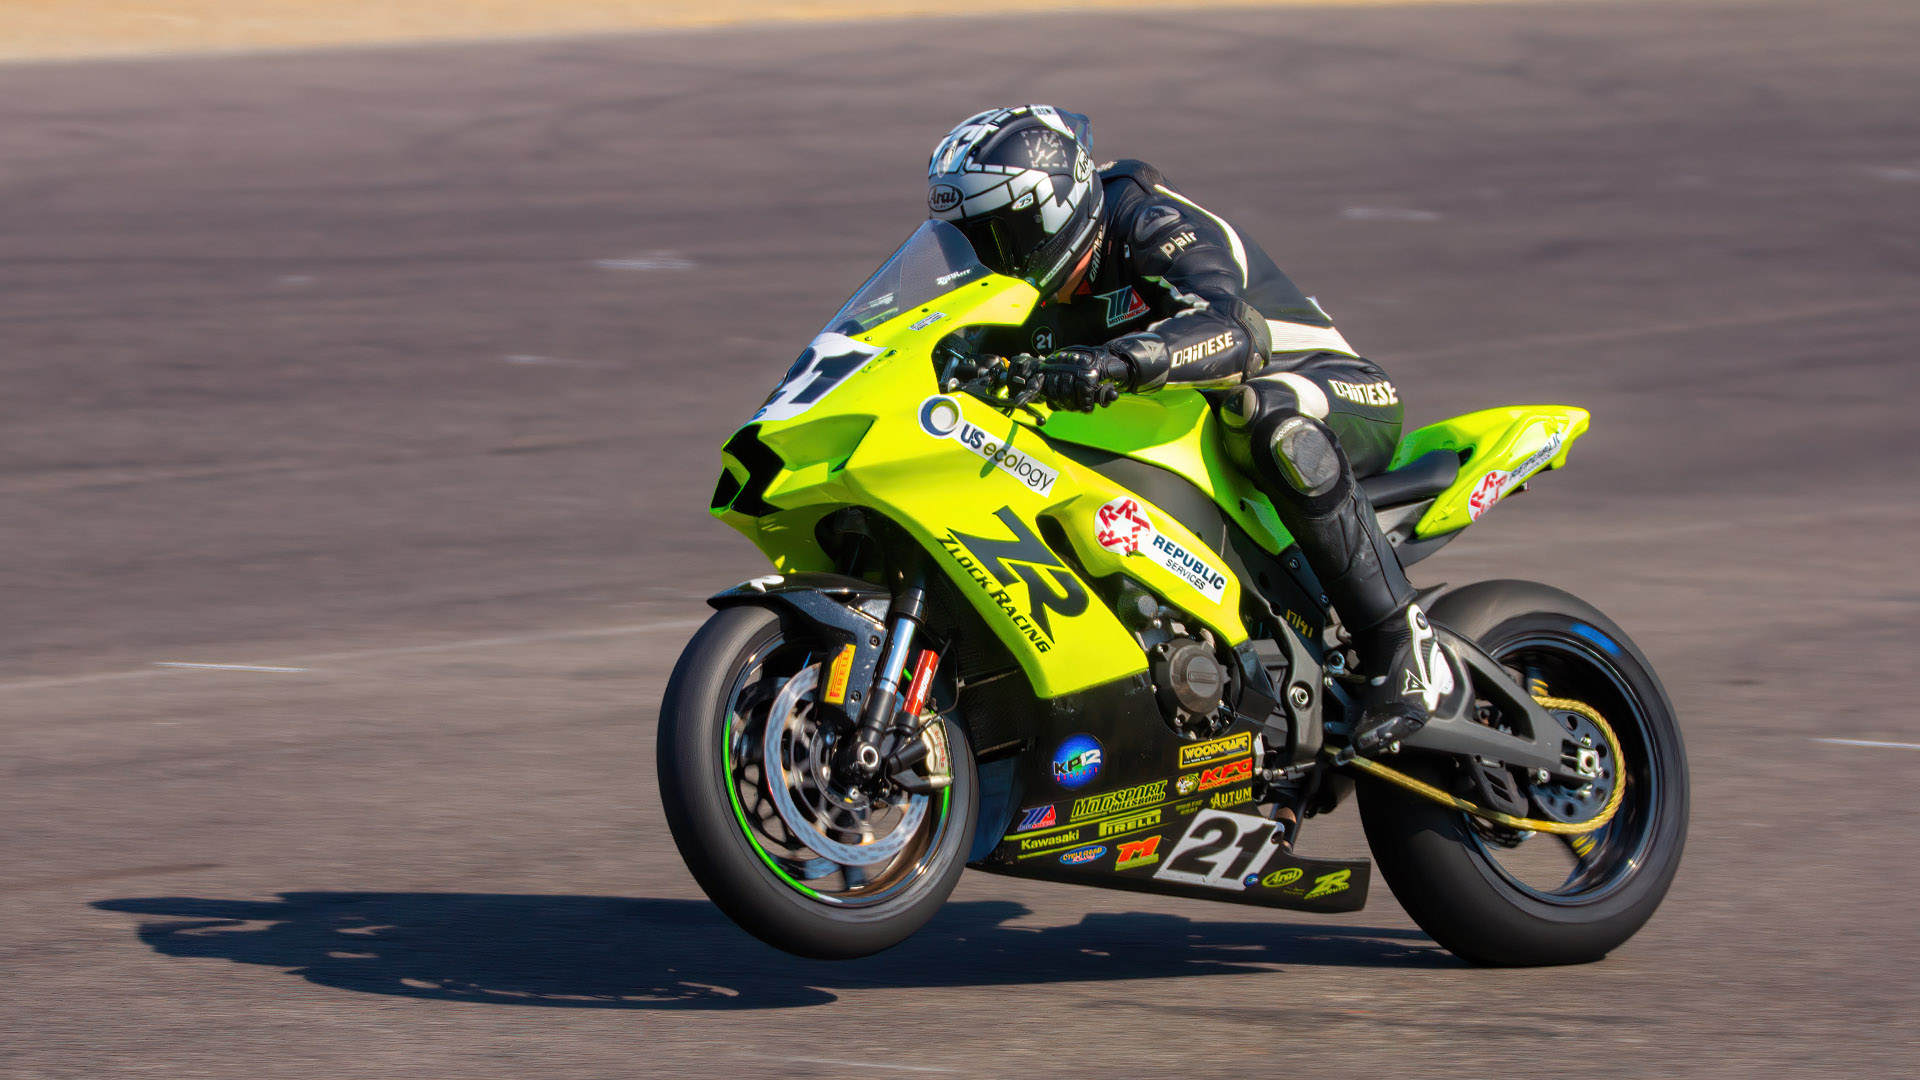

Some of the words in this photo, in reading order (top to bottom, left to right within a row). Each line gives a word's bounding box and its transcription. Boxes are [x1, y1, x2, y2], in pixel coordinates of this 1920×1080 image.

[1036, 333, 1053, 350] 21
[960, 423, 985, 449] US
[983, 441, 1055, 491] ecology
[1152, 534, 1226, 590] REPUBLIC
[1165, 558, 1206, 590] SERVICES
[1053, 748, 1101, 776] KP12
[1098, 808, 1162, 837] PIRELLI
[1021, 829, 1080, 851] Kawasaki
[1166, 816, 1277, 880] 21
